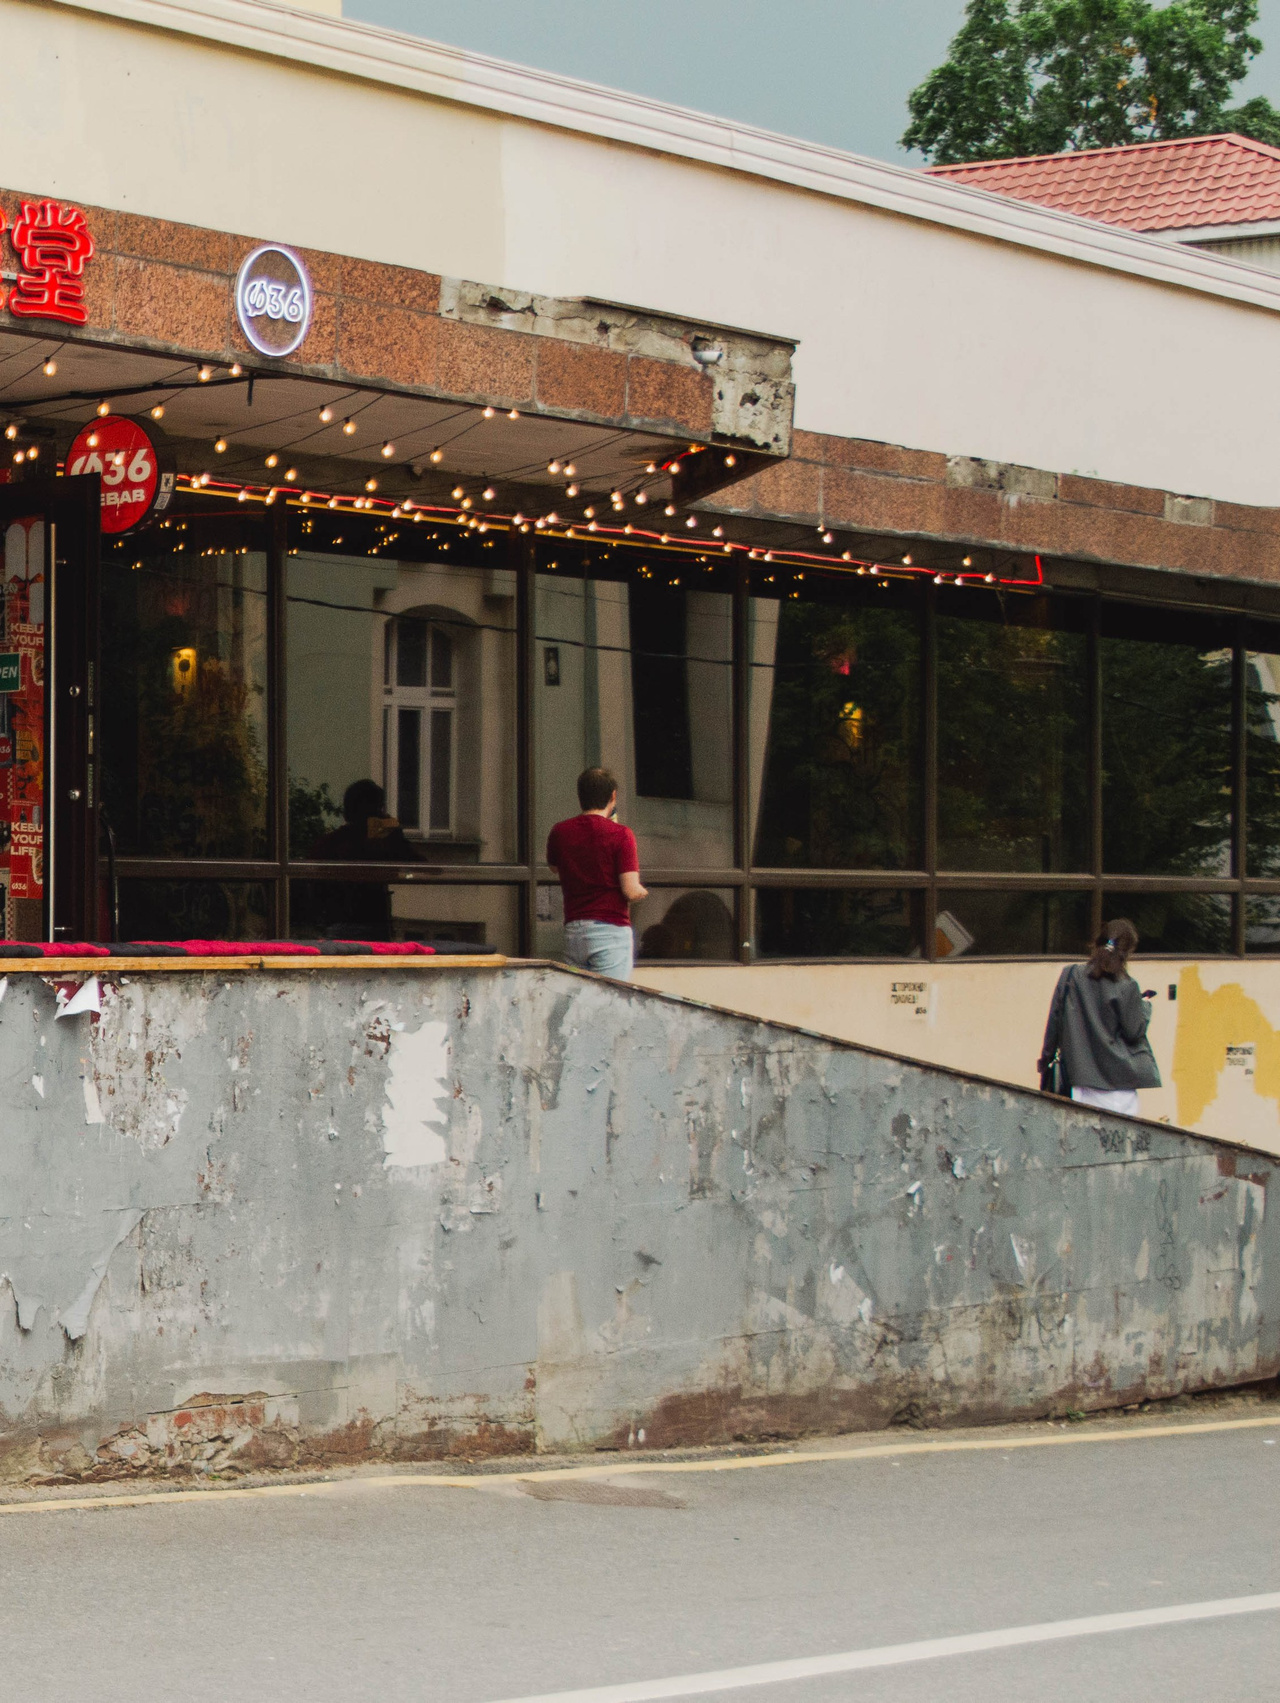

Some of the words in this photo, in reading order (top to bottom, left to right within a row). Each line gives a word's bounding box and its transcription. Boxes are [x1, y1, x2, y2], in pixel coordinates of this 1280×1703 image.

[100, 488, 145, 506] EBAB
[10, 623, 44, 634] KEBU
[11, 822, 43, 833] KEBU
[10, 846, 35, 856] LIFE
